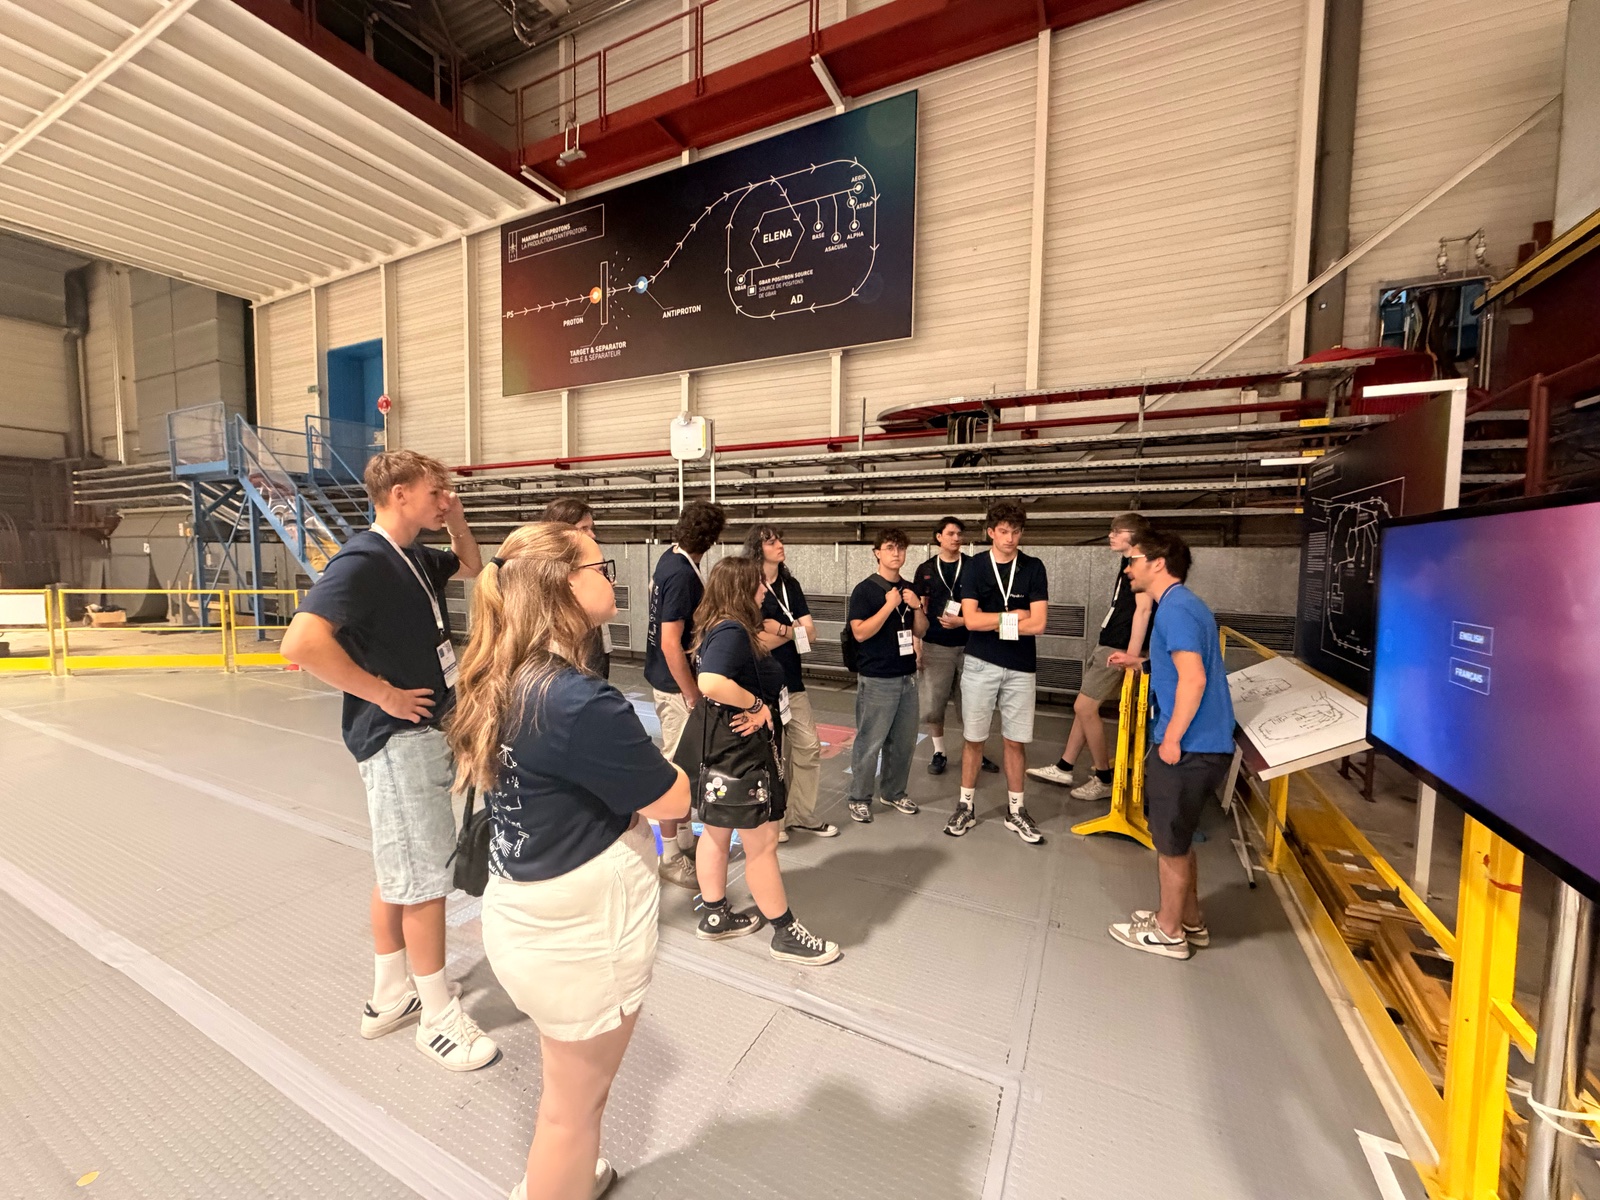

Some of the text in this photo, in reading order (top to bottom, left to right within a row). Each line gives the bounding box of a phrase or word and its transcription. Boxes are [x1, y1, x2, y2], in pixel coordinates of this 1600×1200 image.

[851, 174, 867, 183] AEGIS
[856, 201, 873, 210] ATRAP
[521, 223, 571, 243] MAKING ANTIPROTONS
[763, 229, 793, 243] ELENA
[812, 232, 825, 240] BASE
[847, 231, 864, 240] ALPHA
[528, 236, 554, 248] PRODUCTION
[824, 243, 848, 252] ASACUSA
[771, 274, 794, 283] POSITRON
[794, 269, 814, 278] SOURCE
[758, 284, 775, 292] SOURCE
[790, 294, 804, 305] AD
[506, 310, 514, 319] PS
[662, 304, 702, 319] ANTIPROTON
[563, 317, 584, 327] PROTON
[569, 347, 590, 357] TARGET
[595, 341, 627, 352] SEPARATOR
[569, 355, 584, 364] CIBLE
[1459, 631, 1485, 644] ENGLISH
[1455, 667, 1484, 684] FRANÇAIS
